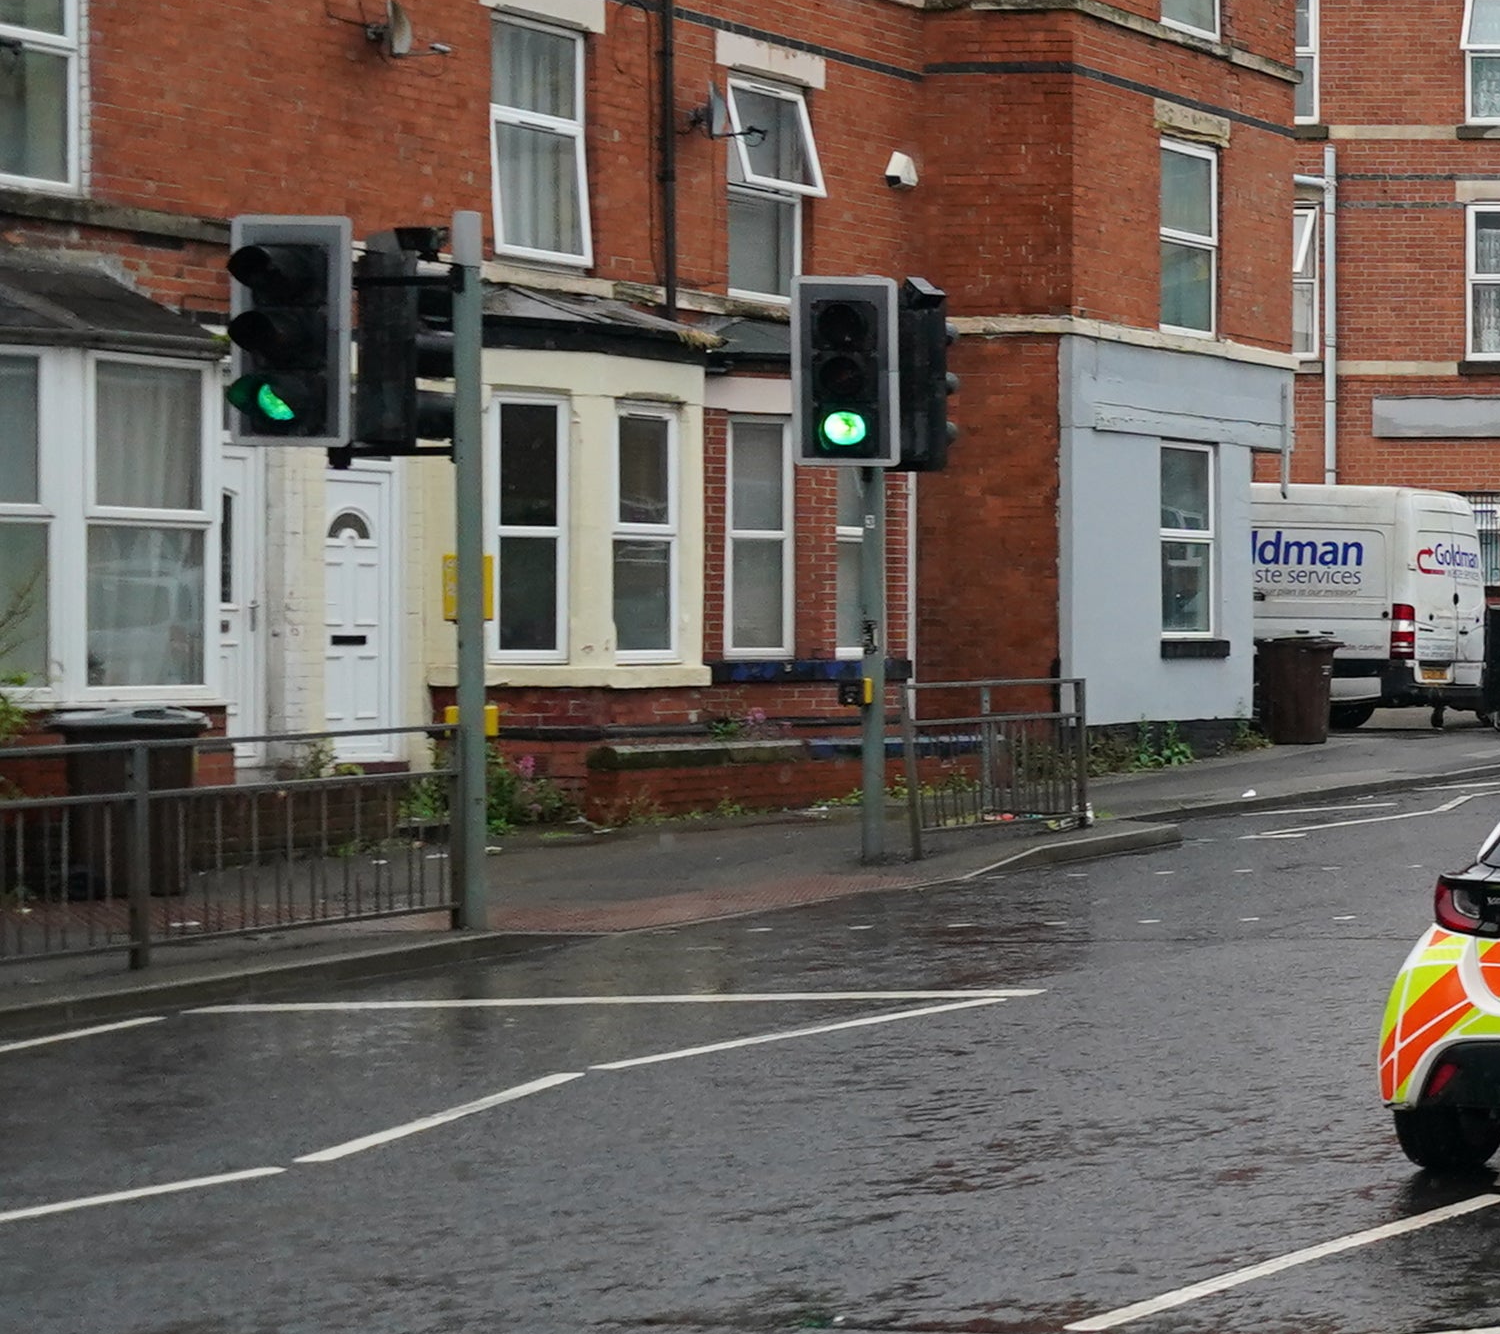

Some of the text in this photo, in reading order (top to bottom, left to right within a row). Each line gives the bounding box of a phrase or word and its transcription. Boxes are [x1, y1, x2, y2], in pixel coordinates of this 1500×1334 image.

[1252, 531, 1363, 567] ldman
[1435, 543, 1478, 568] Goldman
[1288, 568, 1361, 585] services
